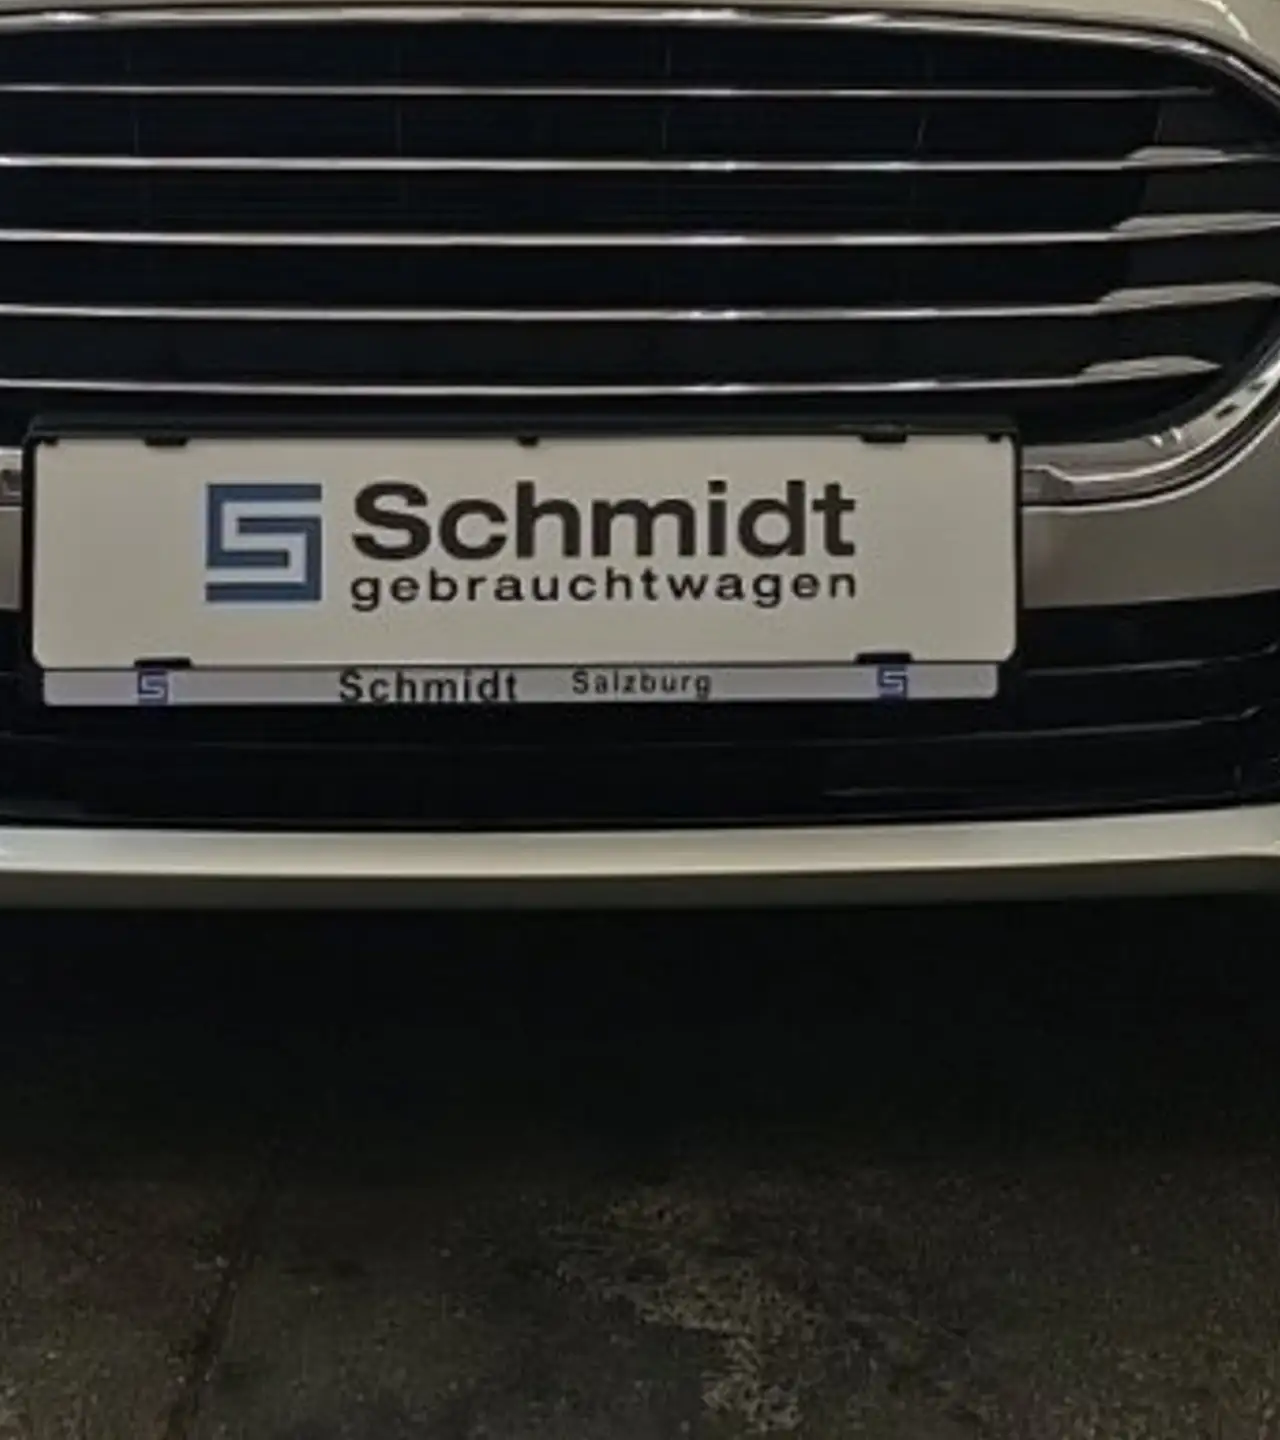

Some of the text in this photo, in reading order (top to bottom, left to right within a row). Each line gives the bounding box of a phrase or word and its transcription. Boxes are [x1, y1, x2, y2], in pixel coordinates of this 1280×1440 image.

[352, 480, 857, 560] Schmidt
[351, 567, 857, 611] gebrauchtwagen
[339, 667, 713, 702] Schmidt Salzburg
